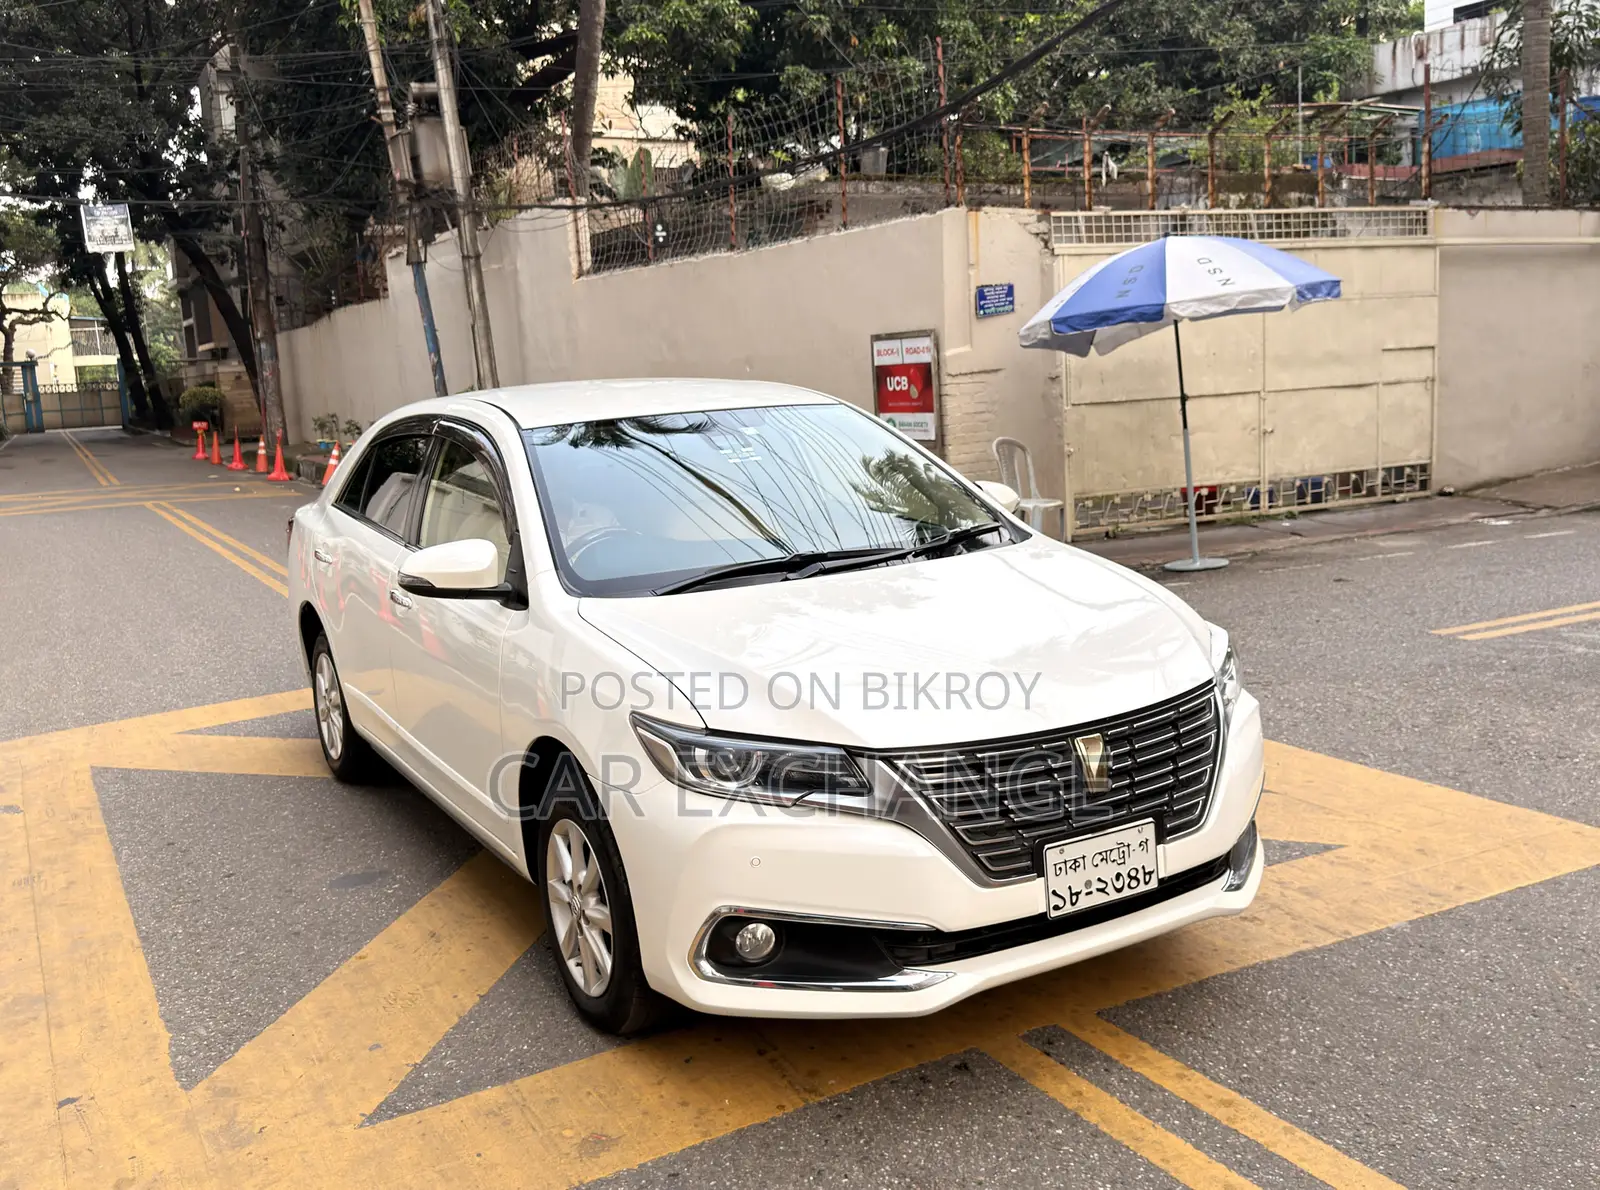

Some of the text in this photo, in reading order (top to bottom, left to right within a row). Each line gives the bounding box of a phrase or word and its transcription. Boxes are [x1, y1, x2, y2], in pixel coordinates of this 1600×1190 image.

[886, 376, 908, 392] UCB
[1053, 854, 1087, 877] ঢাকা
[1051, 864, 1155, 911] ১৮-২৩৪৮
